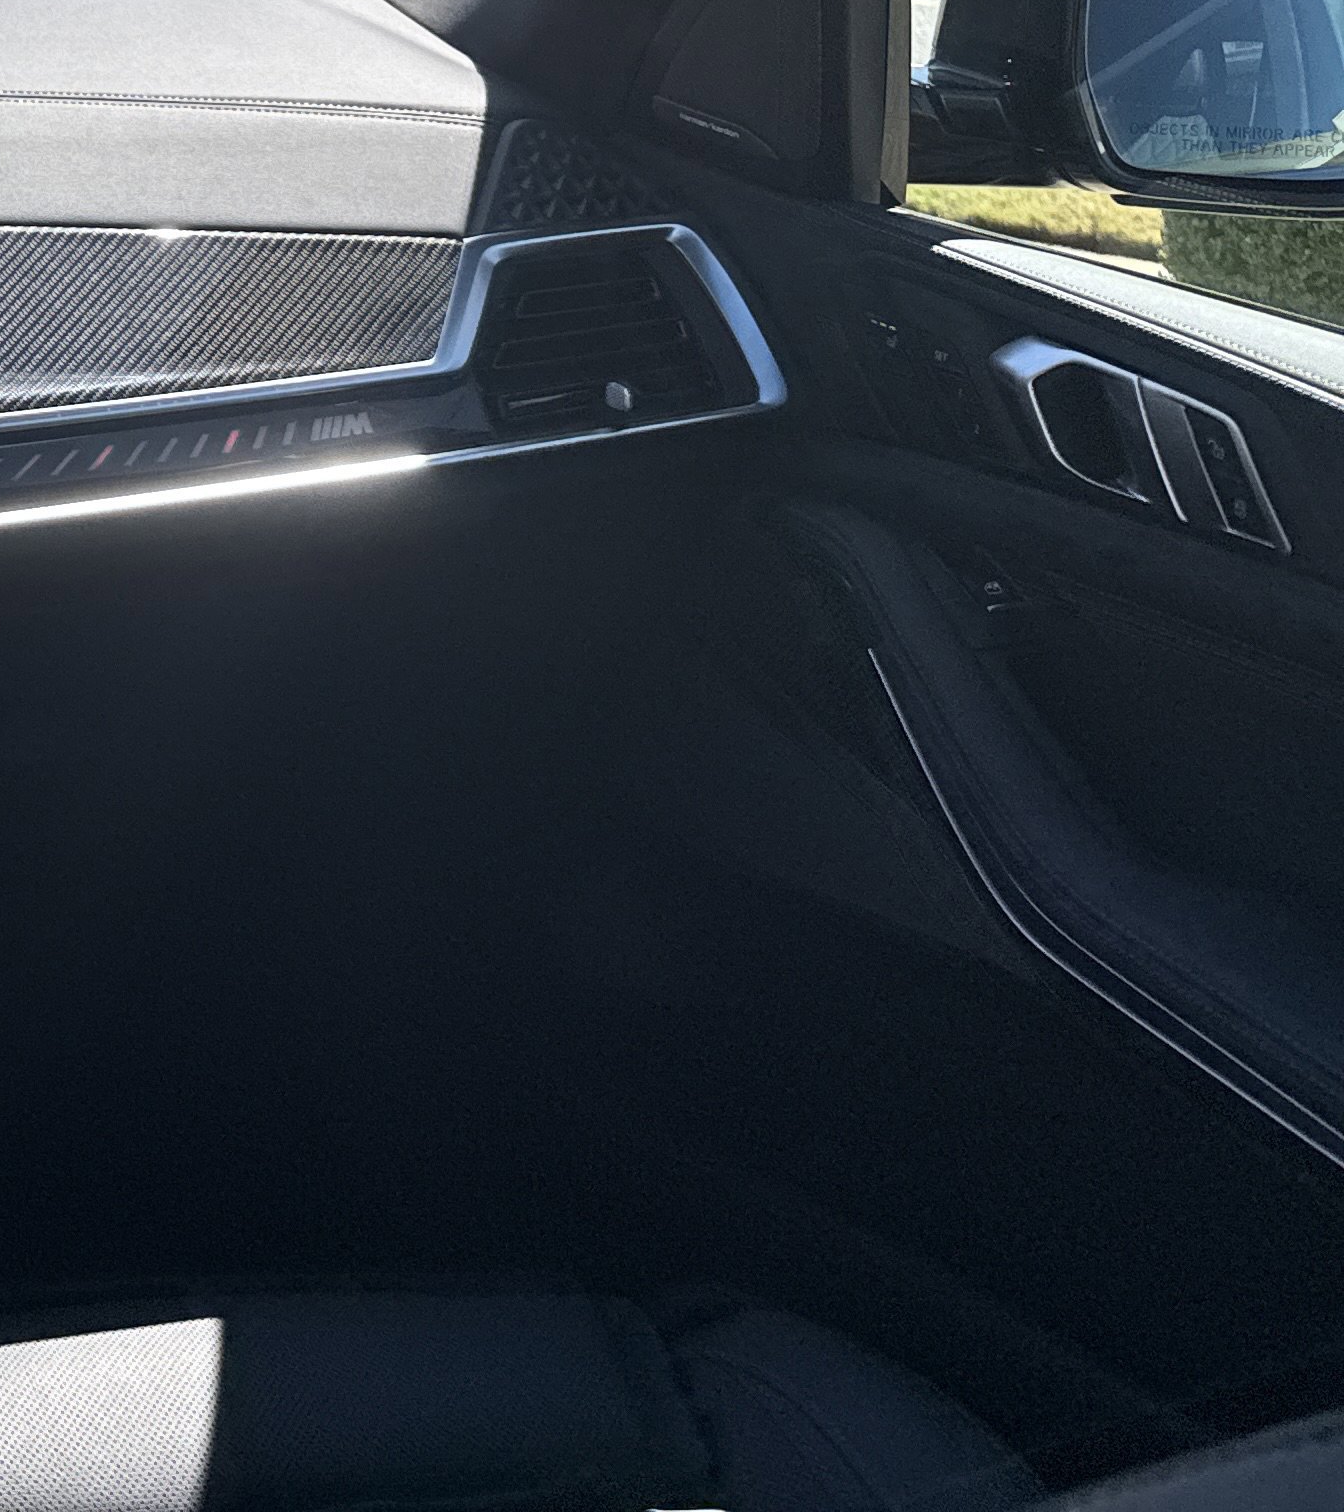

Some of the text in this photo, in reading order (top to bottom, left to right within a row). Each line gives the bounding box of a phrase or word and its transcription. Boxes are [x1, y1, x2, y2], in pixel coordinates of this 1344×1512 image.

[1129, 123, 1202, 137] OBJECTS
[1207, 125, 1219, 138] IN
[1225, 126, 1283, 141] MIRROR
[1293, 128, 1323, 144] ARE
[1181, 138, 1335, 157] THAN THEY APPEAR
